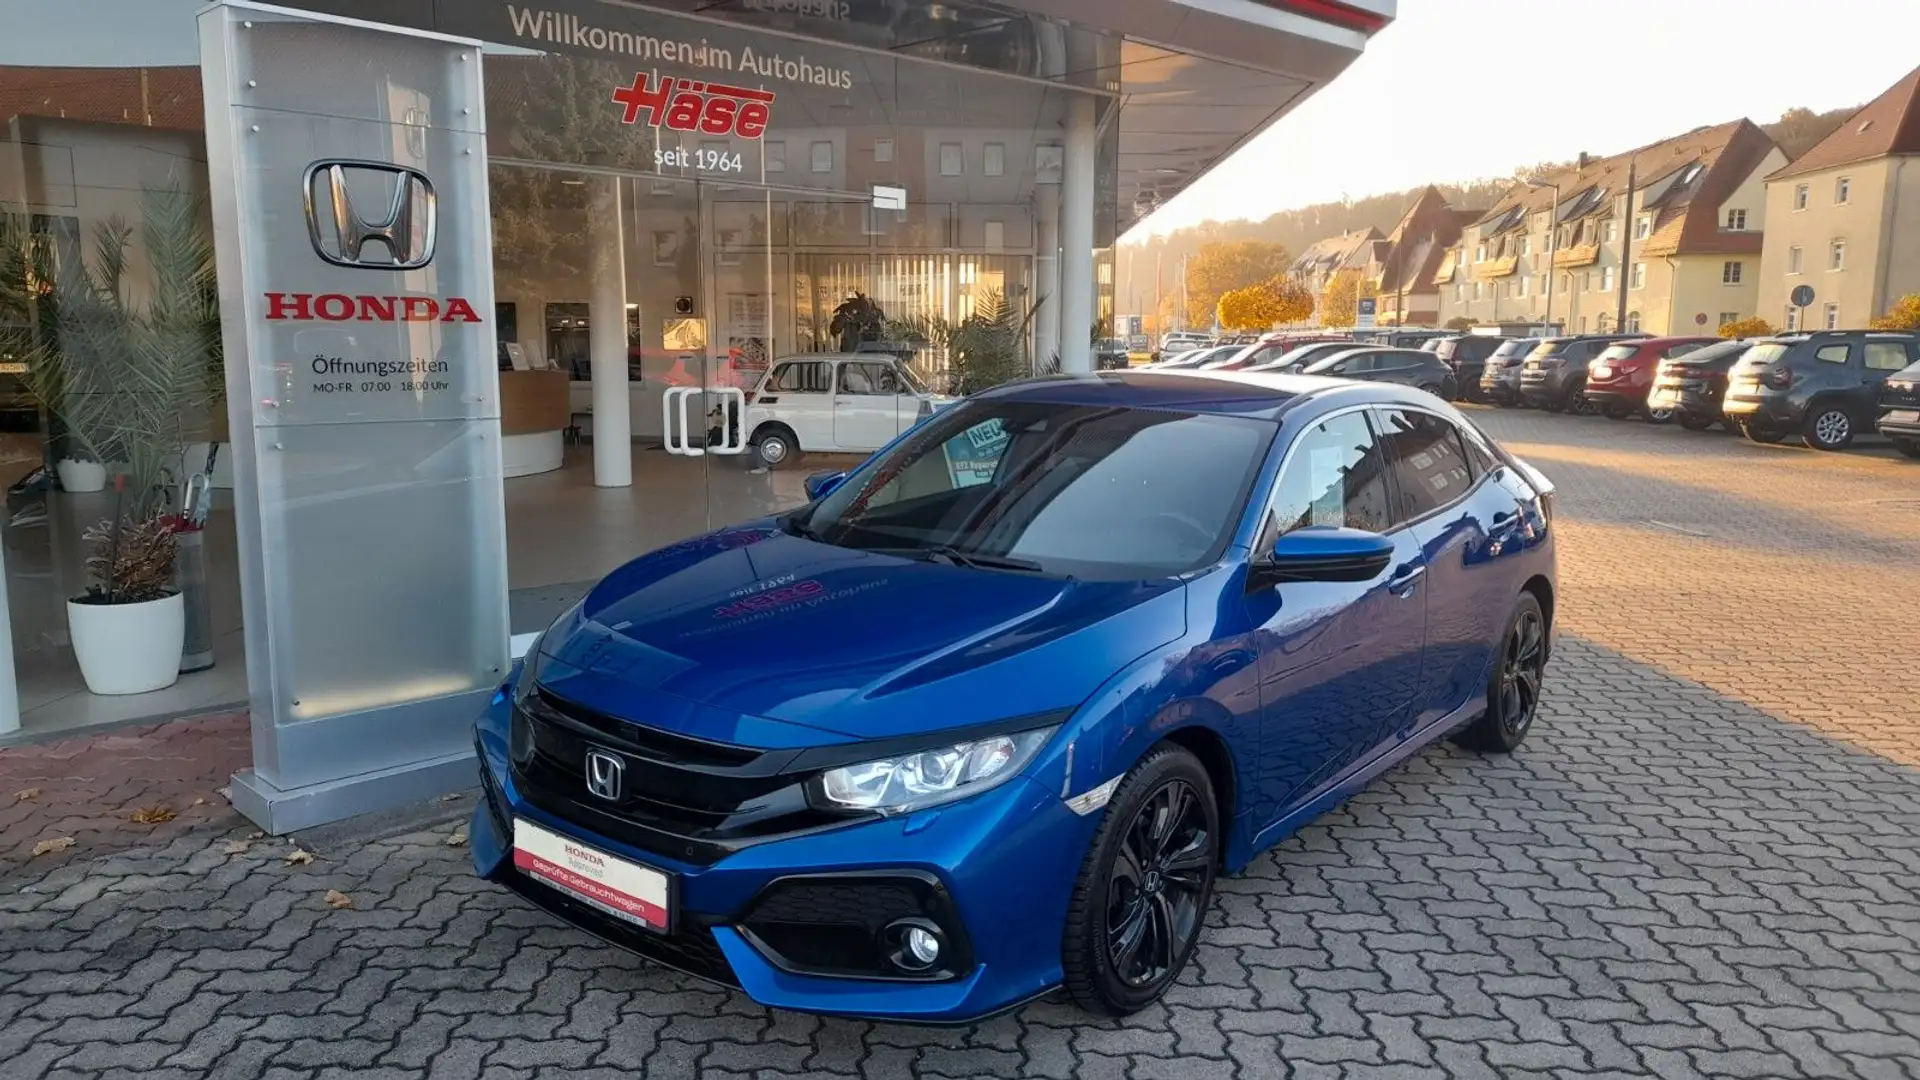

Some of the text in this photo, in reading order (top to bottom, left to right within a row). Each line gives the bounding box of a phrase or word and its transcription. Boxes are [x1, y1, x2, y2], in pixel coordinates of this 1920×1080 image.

[507, 5, 852, 90] Willkommen im Autohaus
[611, 71, 776, 140] Häse
[653, 146, 742, 173] seit 1964
[264, 292, 482, 322] HONDA
[312, 354, 448, 377] Öffnungszeiten
[564, 843, 606, 868] HONDA
[532, 859, 569, 882] Geprüfte
[569, 875, 645, 913] Gebrauchtwagen
